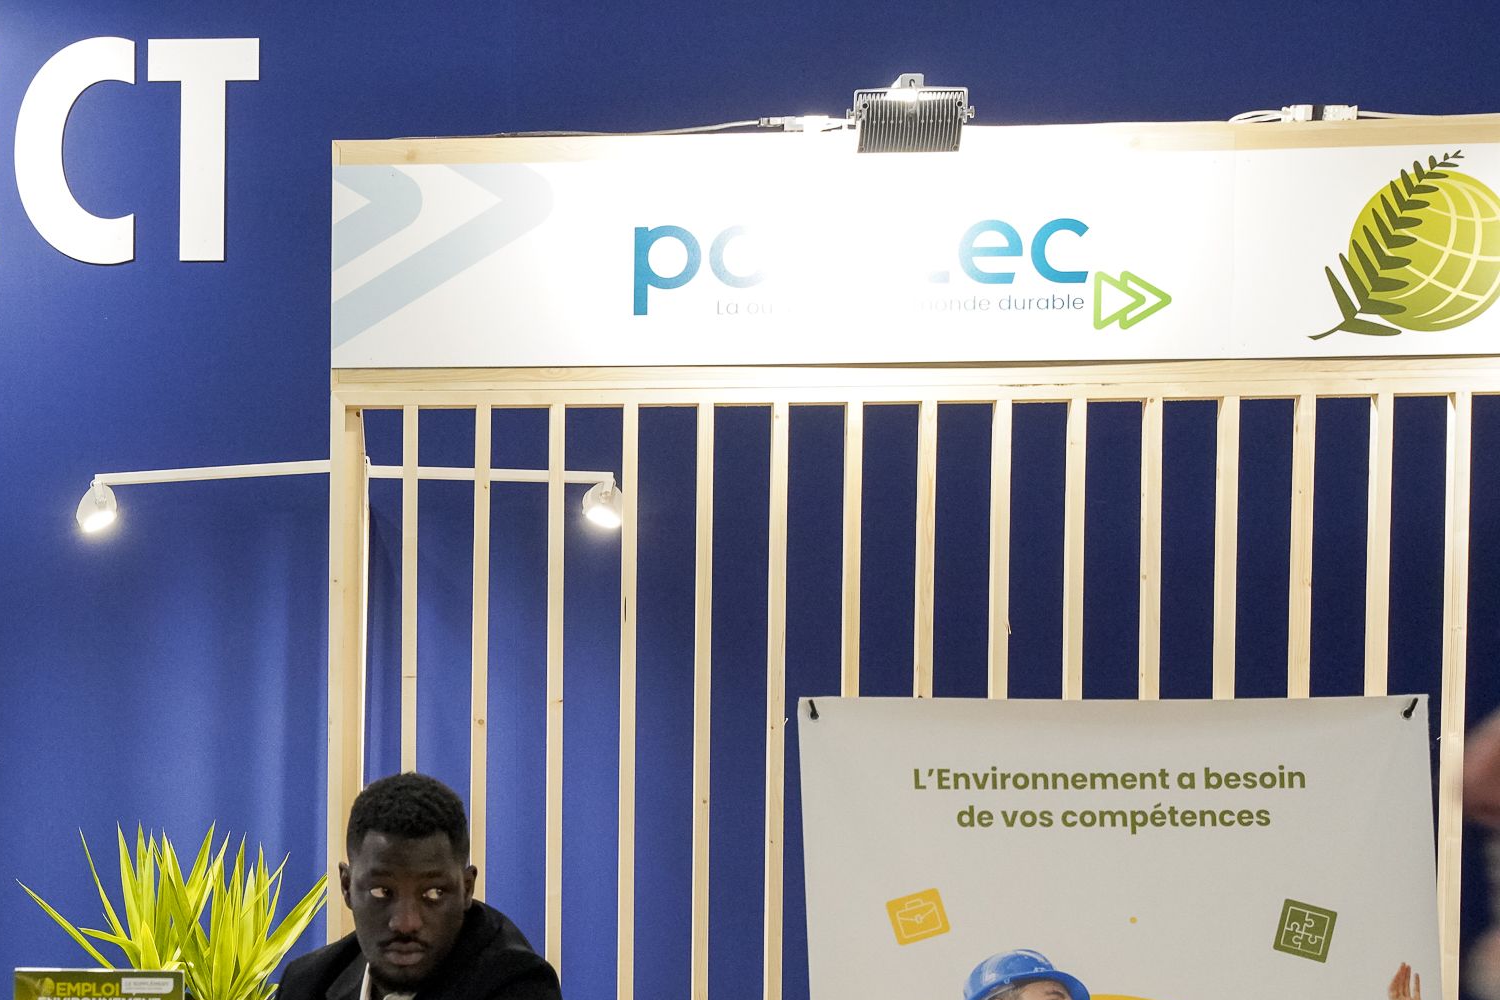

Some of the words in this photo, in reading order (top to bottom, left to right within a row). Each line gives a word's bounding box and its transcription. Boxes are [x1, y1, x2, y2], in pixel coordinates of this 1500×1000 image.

[998, 293, 1085, 310] durable
[913, 766, 1169, 791] L’Environnement
[1177, 772, 1196, 790] a
[1204, 764, 1306, 790] besoin
[957, 805, 994, 828] de
[1001, 809, 1054, 829] vos
[1061, 802, 1271, 836] compétences
[56, 982, 120, 996] EMPLOI
